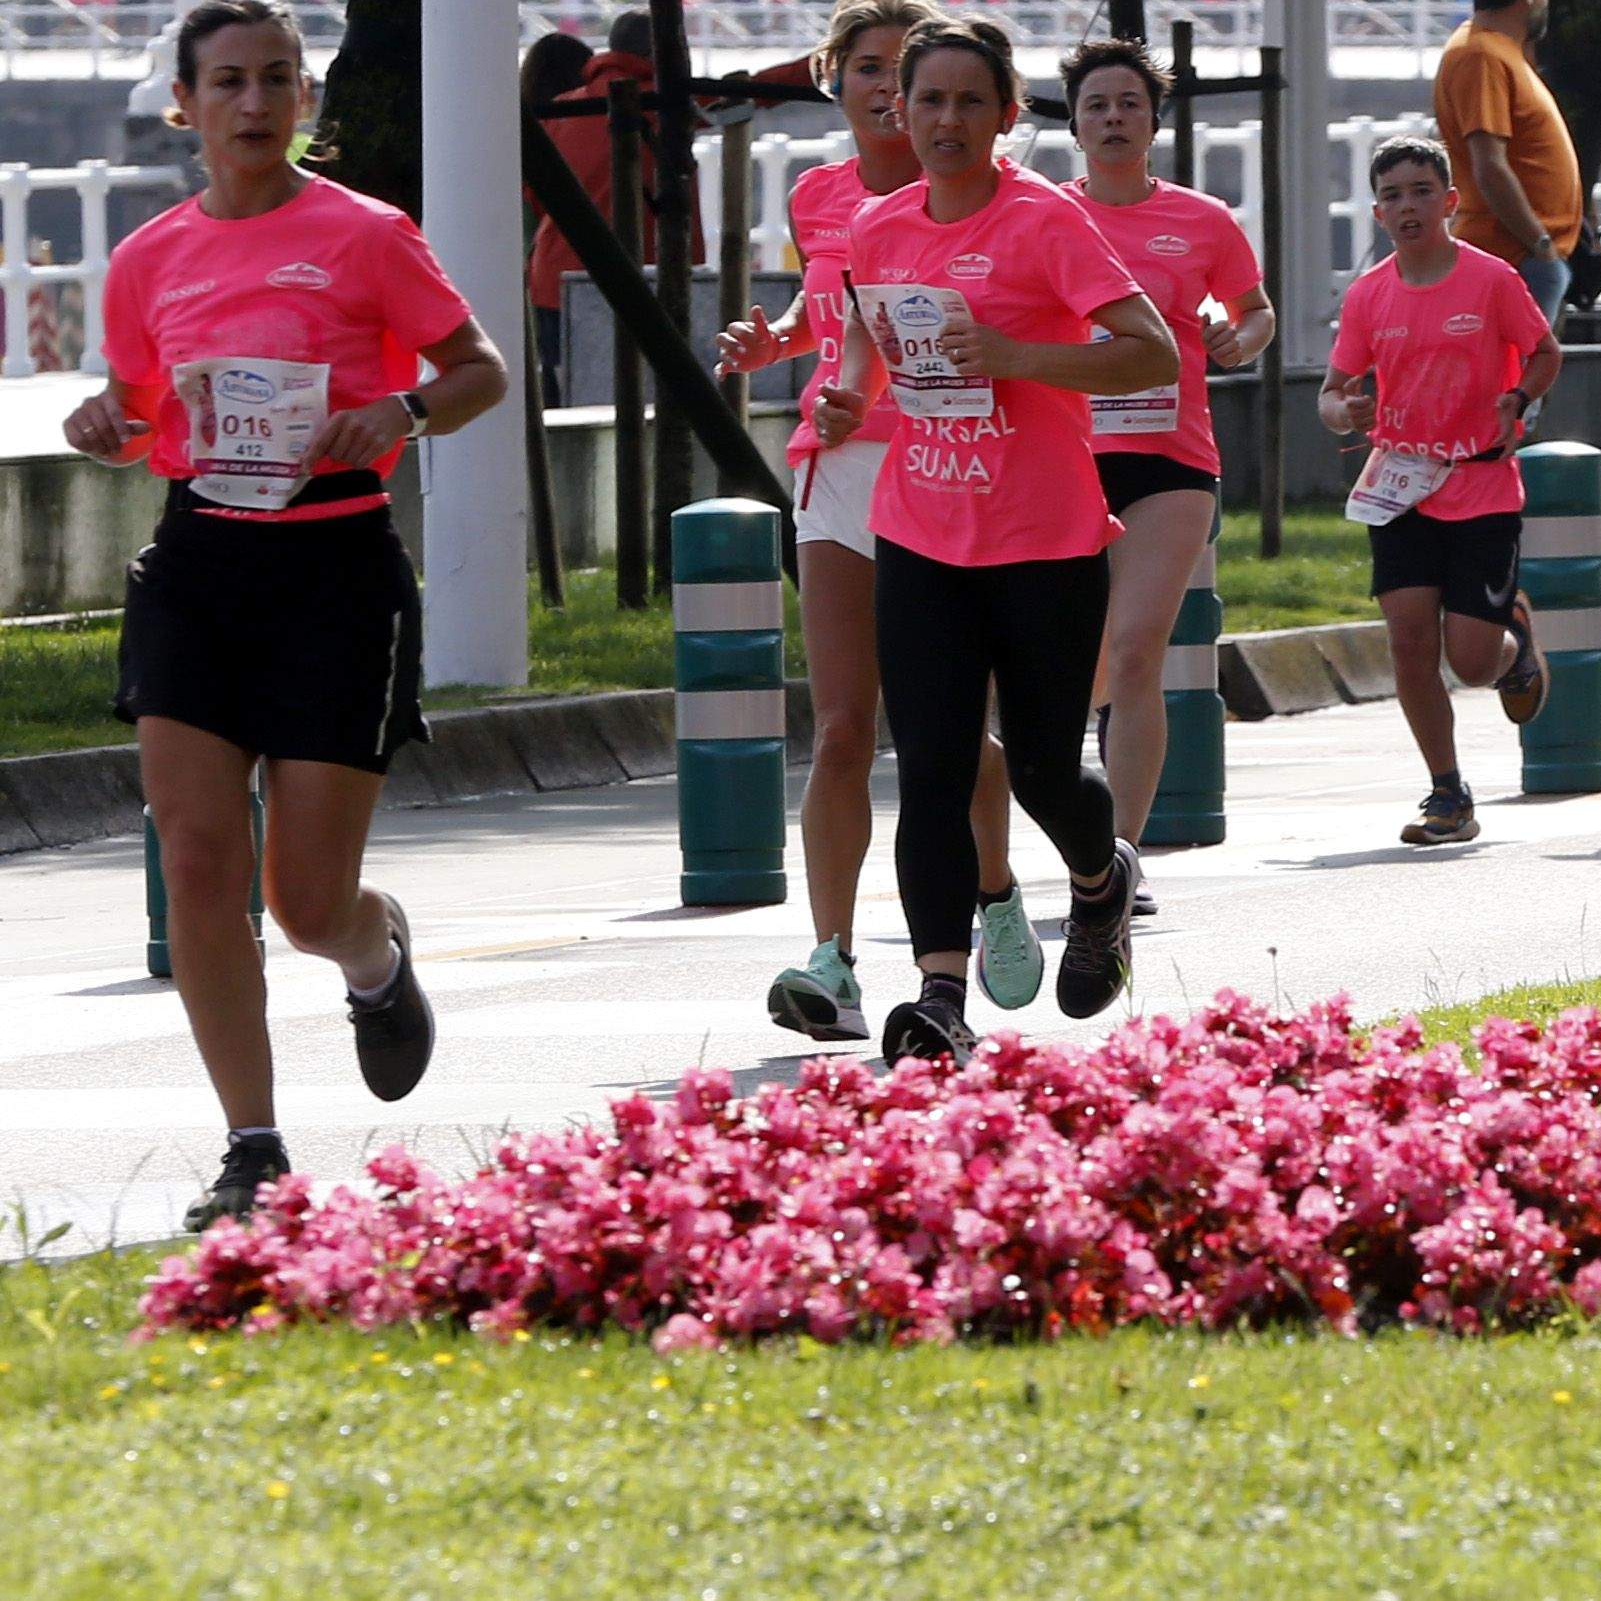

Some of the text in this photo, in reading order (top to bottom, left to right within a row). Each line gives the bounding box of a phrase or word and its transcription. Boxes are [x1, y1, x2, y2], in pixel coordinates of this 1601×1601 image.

[916, 361, 945, 374] 2442
[222, 414, 273, 438] 016
[1383, 406, 1406, 430] TU
[235, 444, 264, 457] 412
[906, 444, 991, 482] SUMA
[1382, 469, 1410, 489] 016
